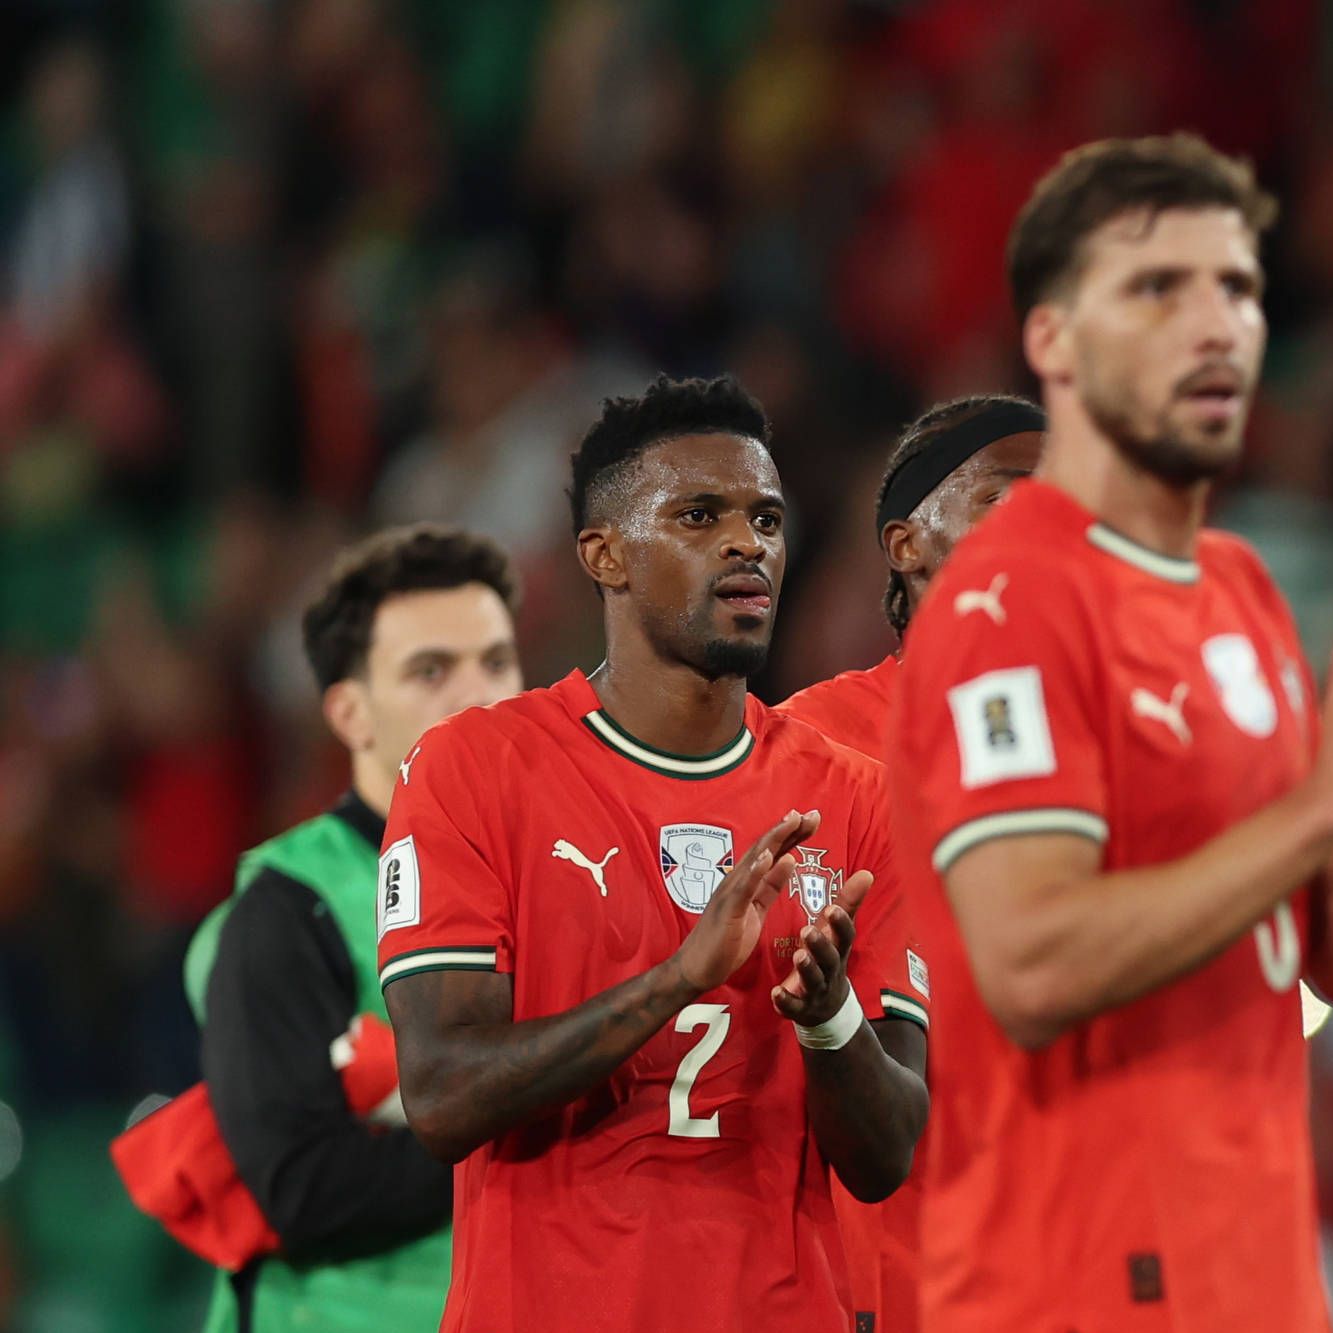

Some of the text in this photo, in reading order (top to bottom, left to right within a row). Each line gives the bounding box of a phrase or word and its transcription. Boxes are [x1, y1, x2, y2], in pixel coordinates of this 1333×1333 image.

[664, 828, 678, 836] UEFA
[705, 828, 728, 839] LEAGUE
[667, 1003, 731, 1138] 2
